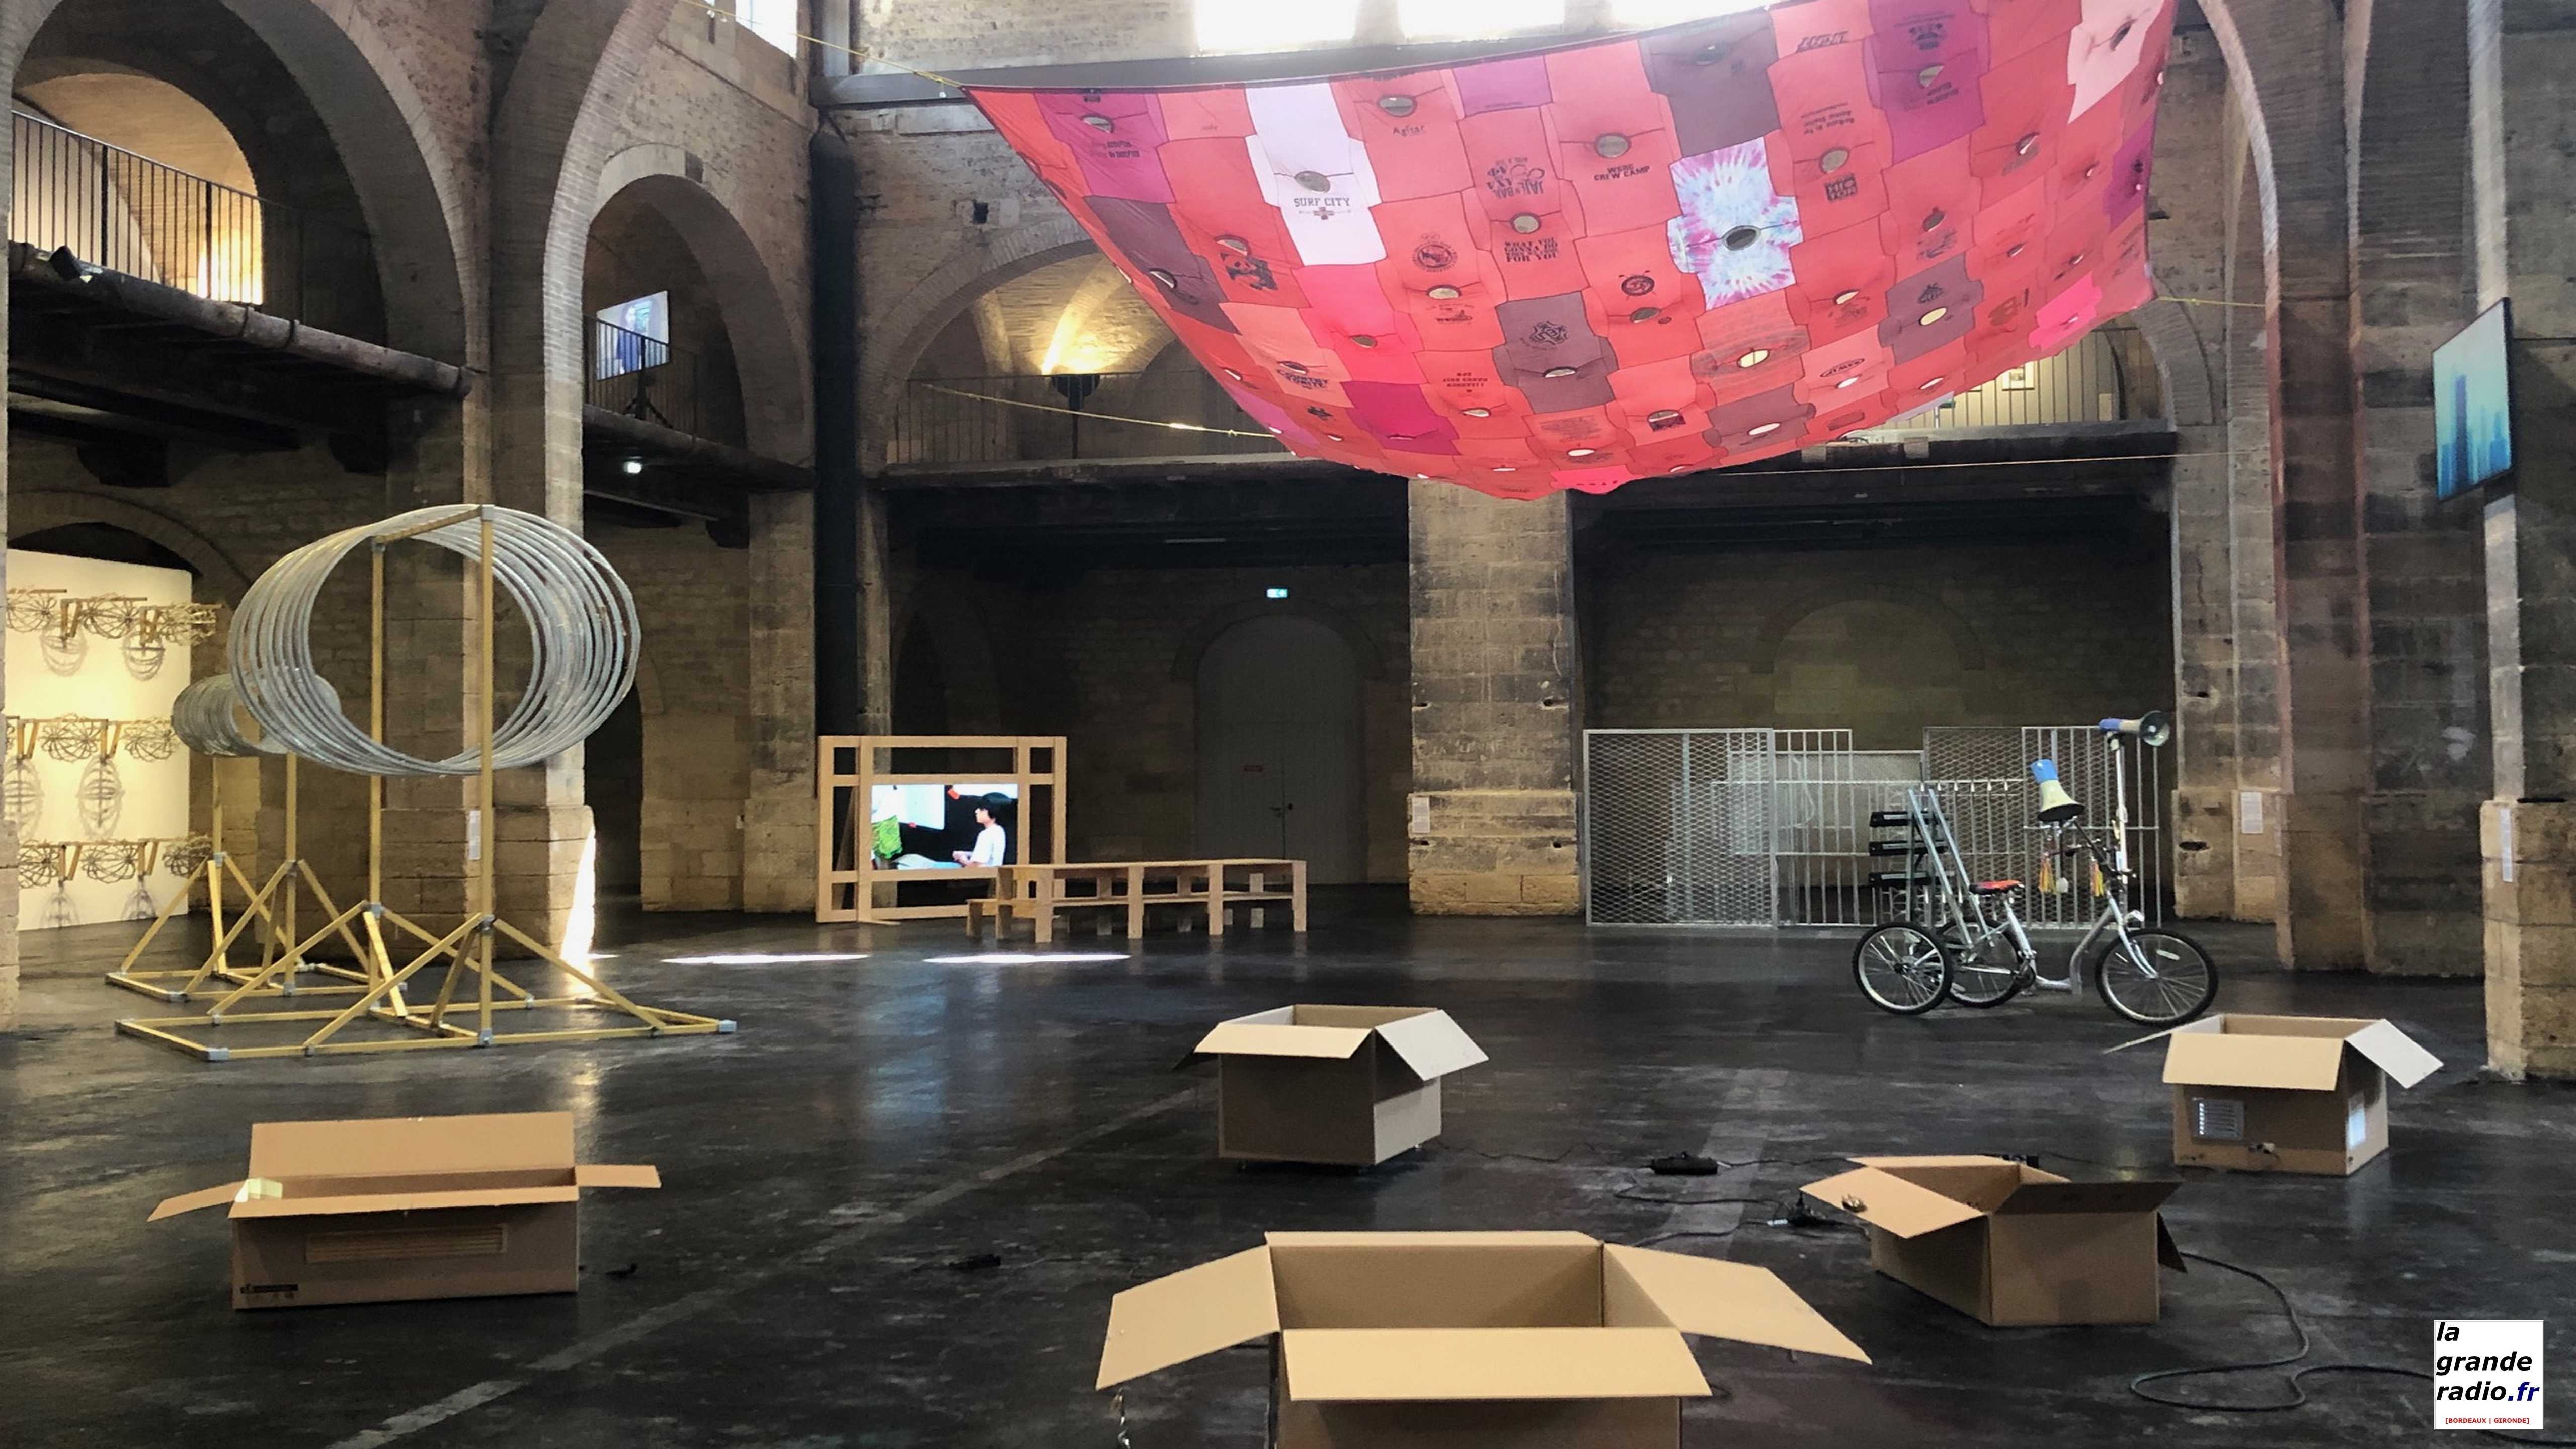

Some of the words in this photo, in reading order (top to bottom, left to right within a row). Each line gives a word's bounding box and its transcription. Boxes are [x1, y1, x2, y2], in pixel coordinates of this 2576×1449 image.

[1593, 172, 1620, 181] CREW
[1624, 166, 1650, 177] CAMP
[1294, 198, 1321, 207] SURF
[1324, 197, 1350, 206] CITY
[1534, 252, 1556, 261] YOU
